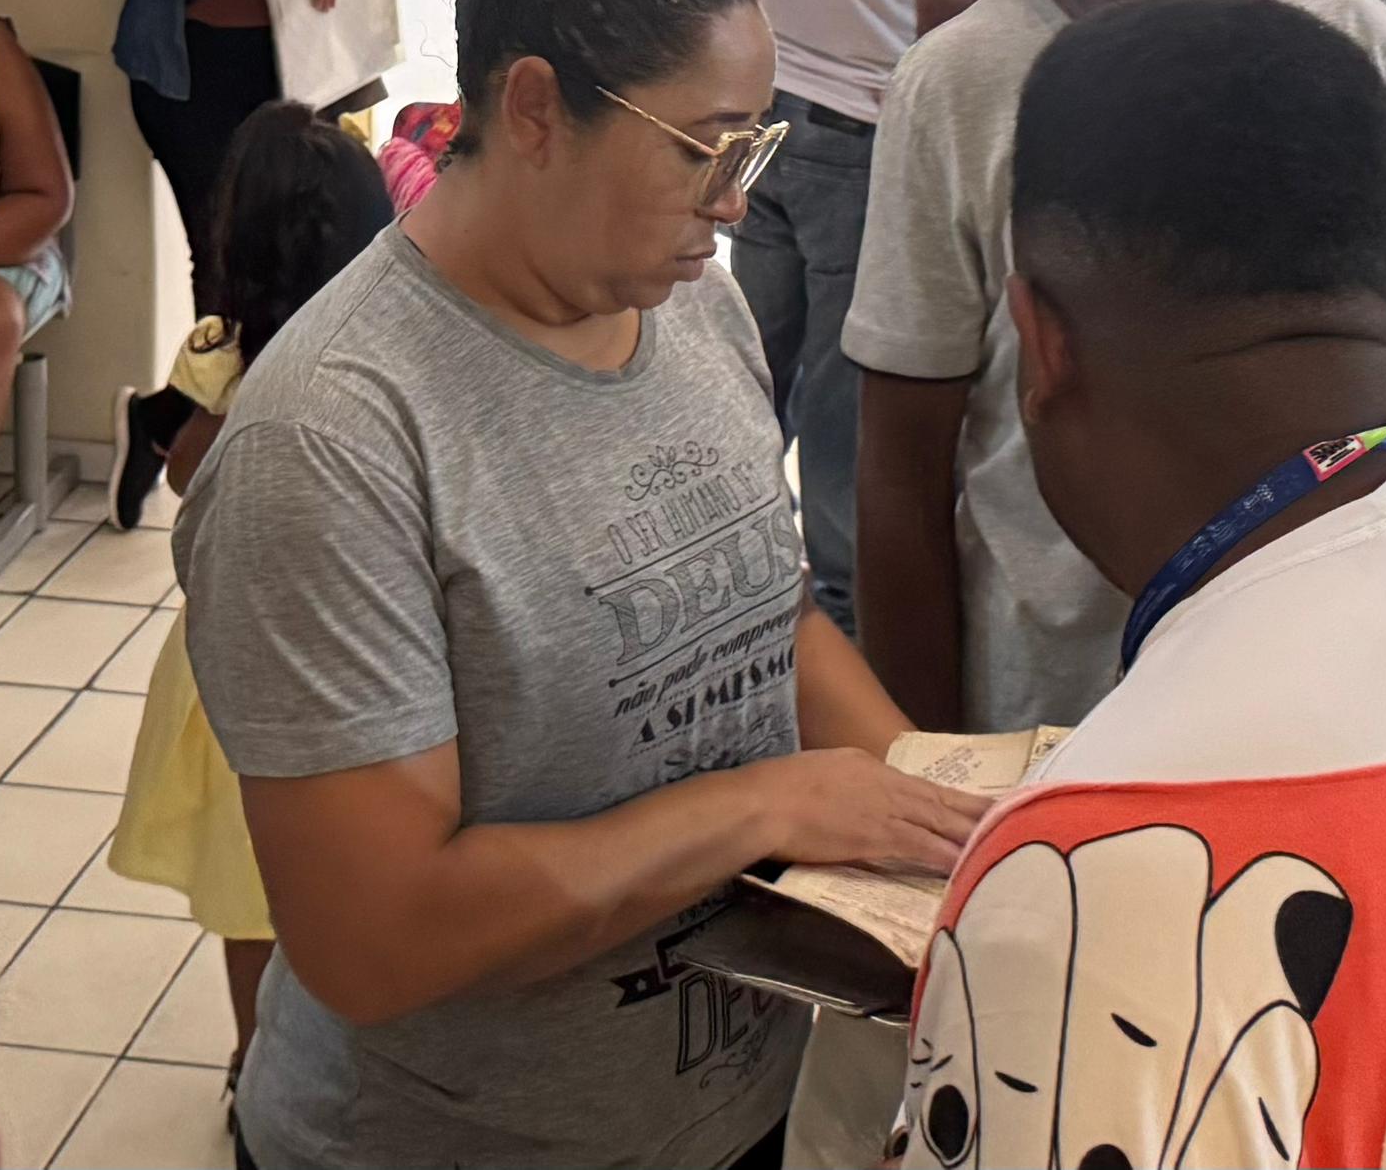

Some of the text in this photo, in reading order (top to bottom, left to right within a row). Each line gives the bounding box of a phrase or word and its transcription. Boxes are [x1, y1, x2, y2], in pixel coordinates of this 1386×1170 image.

[626, 510, 668, 557] SER
[598, 506, 803, 666] DEUS
[614, 680, 659, 718] não
[656, 644, 709, 703] pode
[628, 718, 656, 751] A
[665, 696, 696, 732] SI
